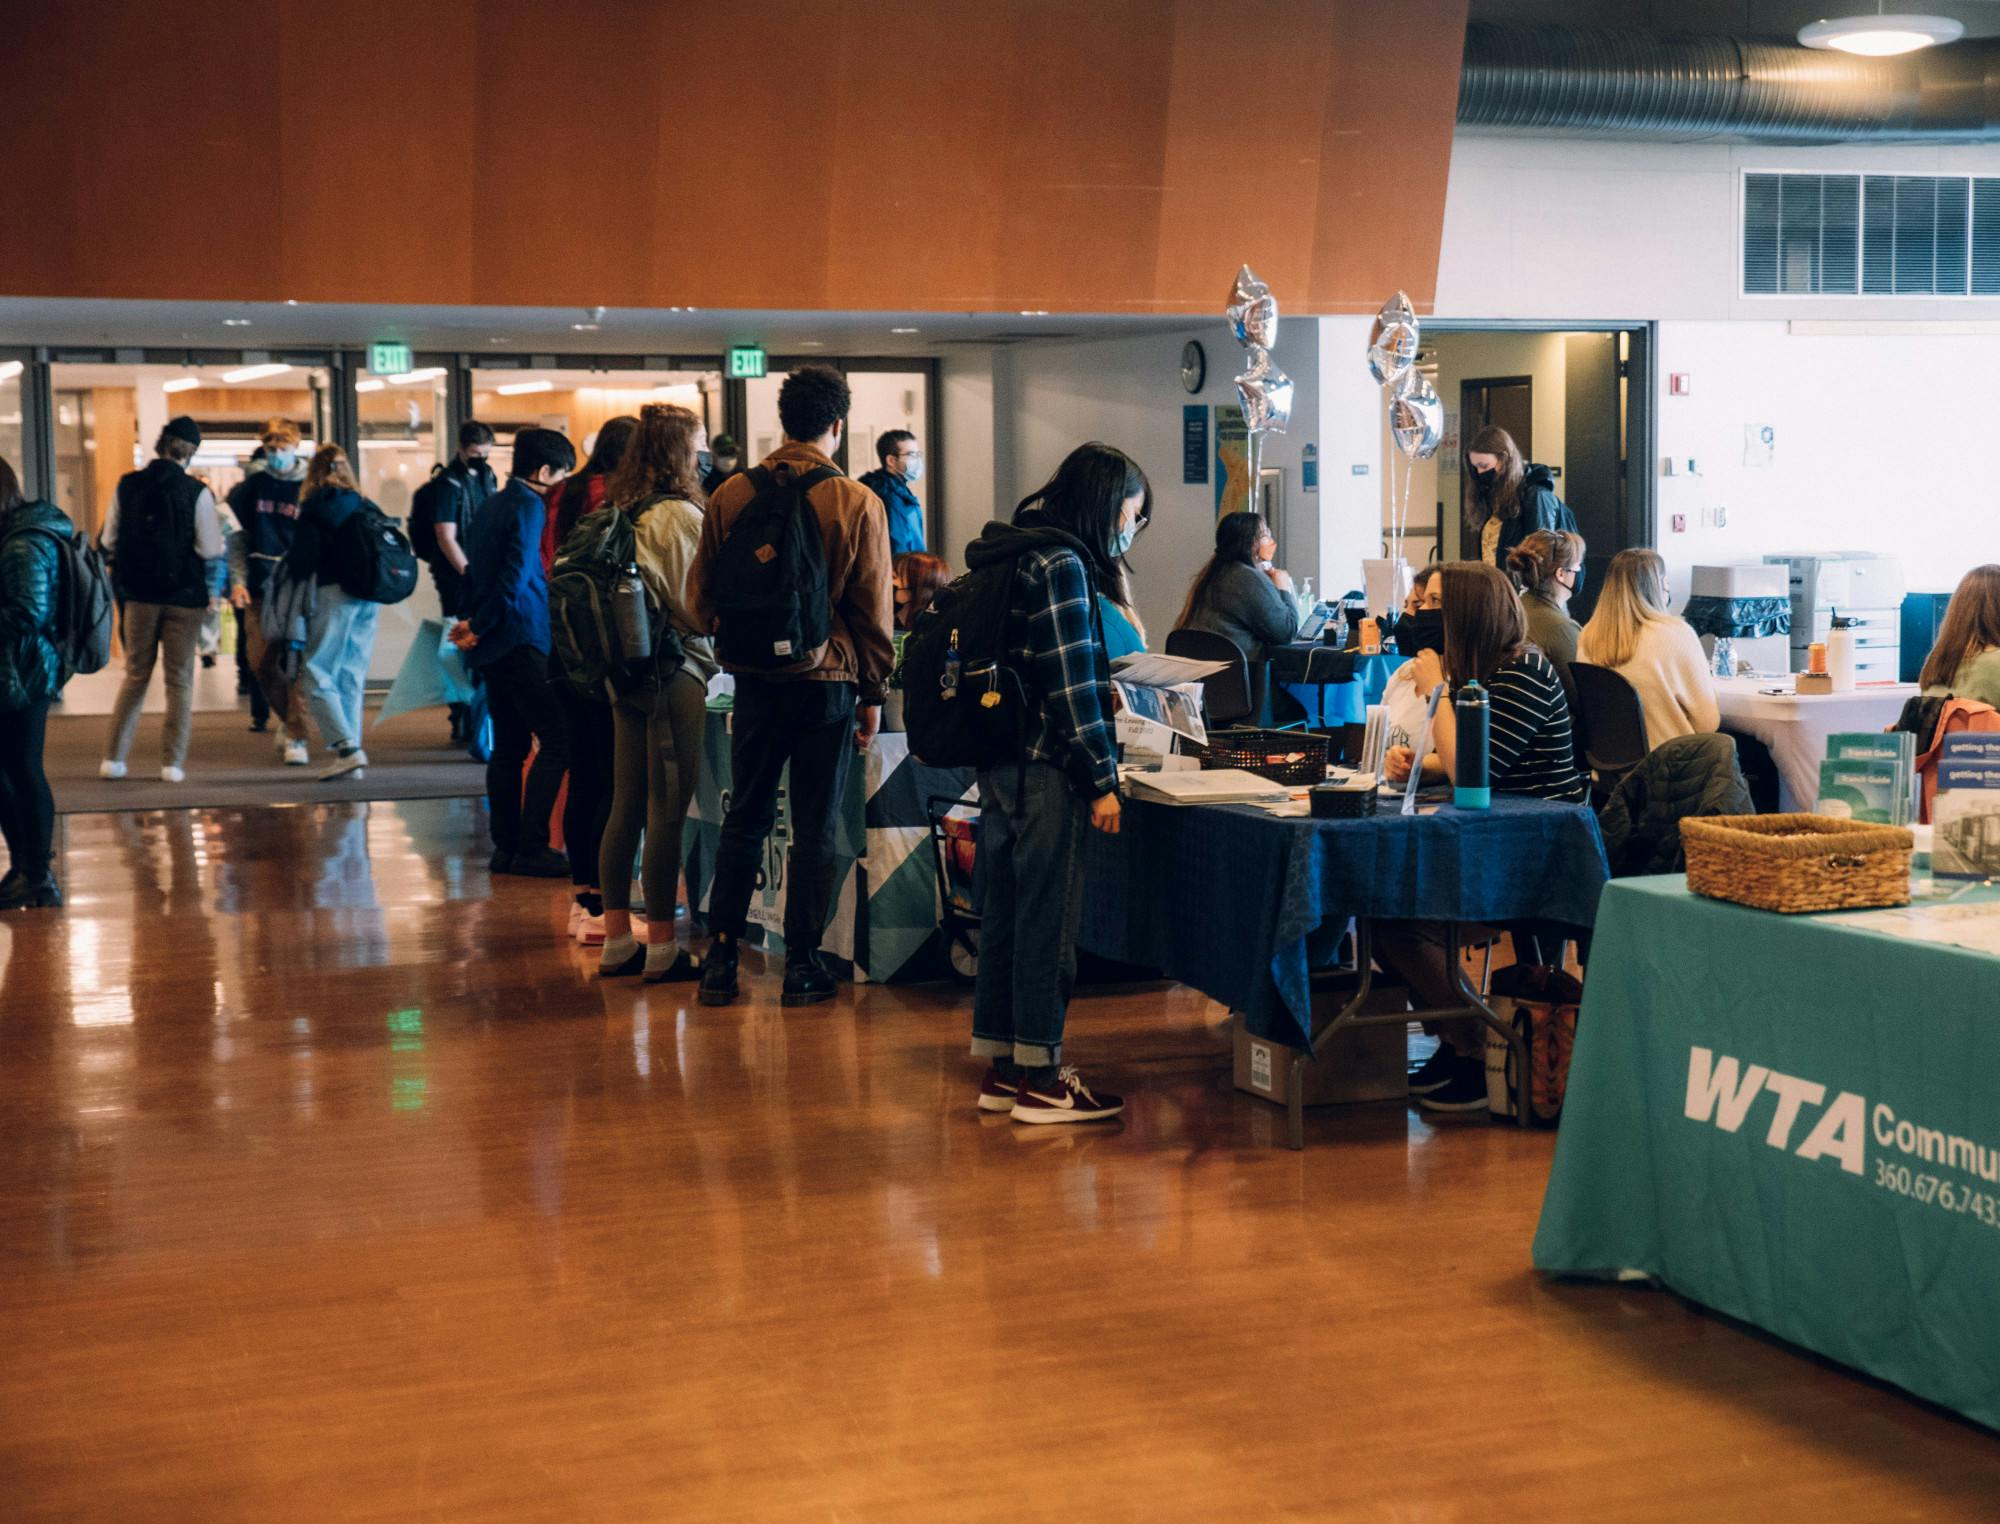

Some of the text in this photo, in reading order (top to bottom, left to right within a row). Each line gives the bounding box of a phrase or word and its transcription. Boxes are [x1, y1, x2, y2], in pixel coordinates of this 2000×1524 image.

[373, 346, 408, 373] EXIT
[731, 351, 764, 377] EXIT
[1873, 749, 1897, 758] Guide
[1950, 744, 1984, 753] getting
[1839, 774, 1891, 785] Transit Guide
[1949, 771, 1983, 780] getting
[1684, 1045, 2000, 1184] WTA Commu
[1875, 1158, 2000, 1231] 360.676.743
